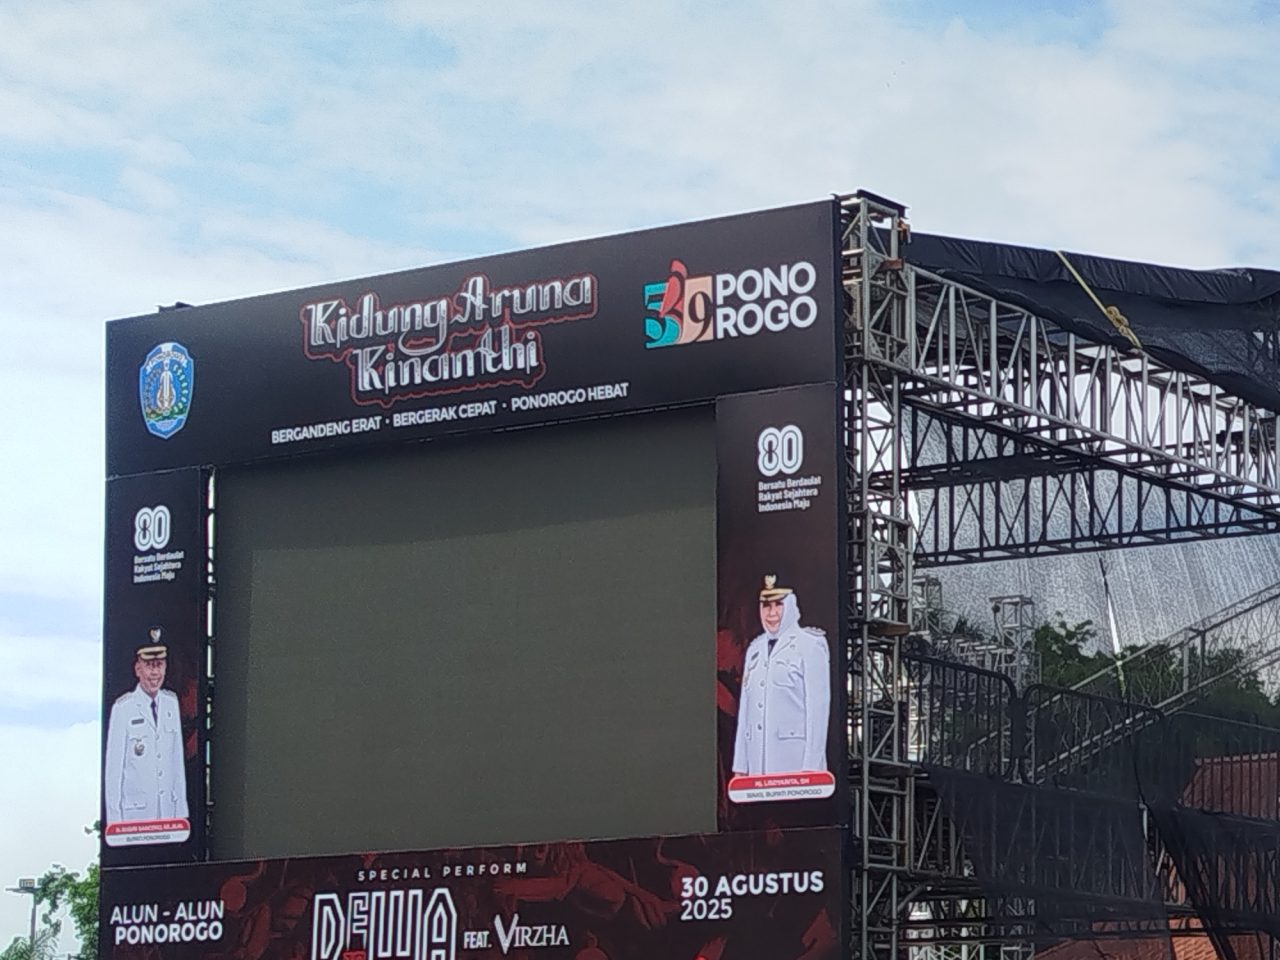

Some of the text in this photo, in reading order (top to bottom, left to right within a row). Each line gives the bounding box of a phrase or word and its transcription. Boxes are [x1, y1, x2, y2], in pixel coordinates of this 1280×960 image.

[716, 261, 816, 305] PONO
[307, 275, 592, 356] Kidung Aruna
[716, 295, 817, 339] ROGO
[353, 324, 539, 394] Kinanthi
[271, 382, 629, 444] BERGANDENG ERAT BERGERAK CEPAT PONOROGO HEBAT
[758, 424, 804, 477] 80
[134, 505, 170, 551] 80
[357, 862, 527, 881] SPECIAL PERFORM
[680, 871, 824, 898] 30 AGUSTUS
[109, 904, 158, 925] ALUN
[174, 900, 225, 921] ALUN
[680, 898, 733, 920] 2025
[115, 921, 223, 945] PONOROGO
[463, 931, 493, 950] FEAT.
